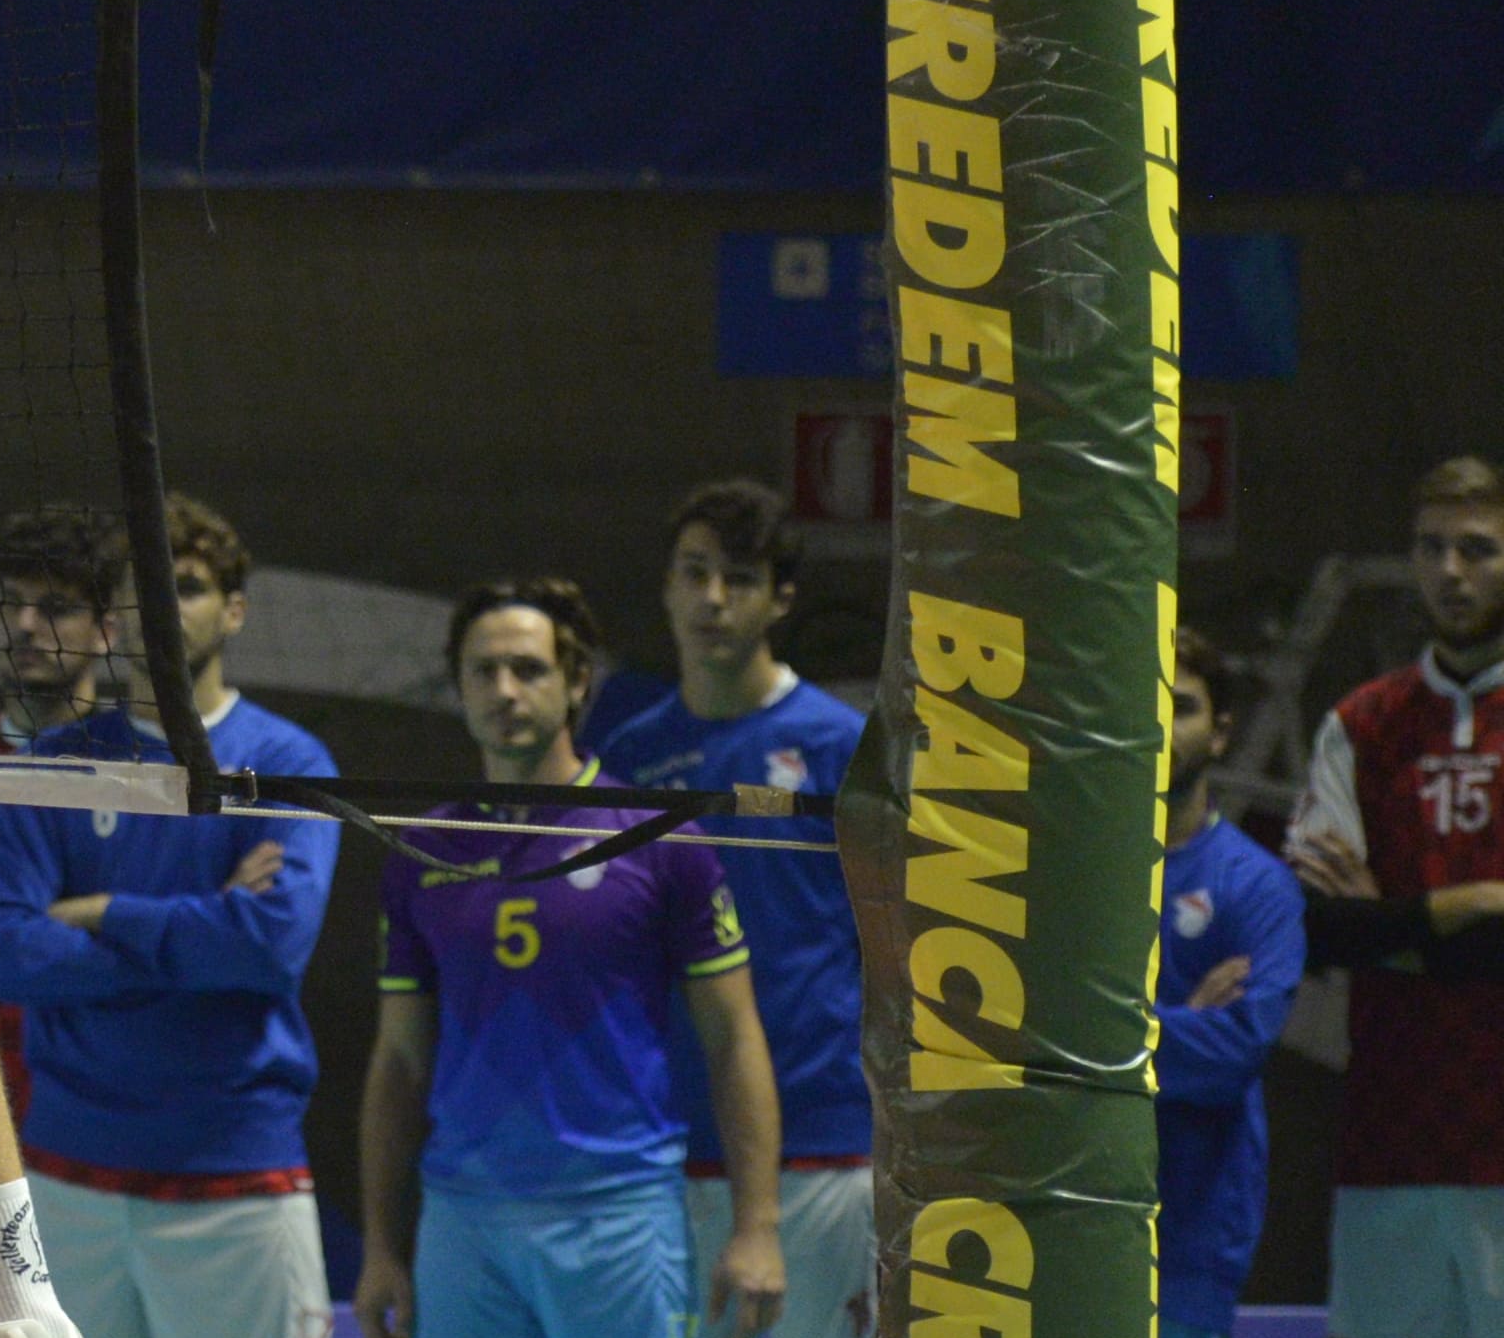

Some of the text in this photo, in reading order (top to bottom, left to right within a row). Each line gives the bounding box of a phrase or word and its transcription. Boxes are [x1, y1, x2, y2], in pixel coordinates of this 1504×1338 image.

[1418, 770, 1491, 835] 15
[907, 591, 1029, 1091] BANCA
[495, 900, 540, 969] 5
